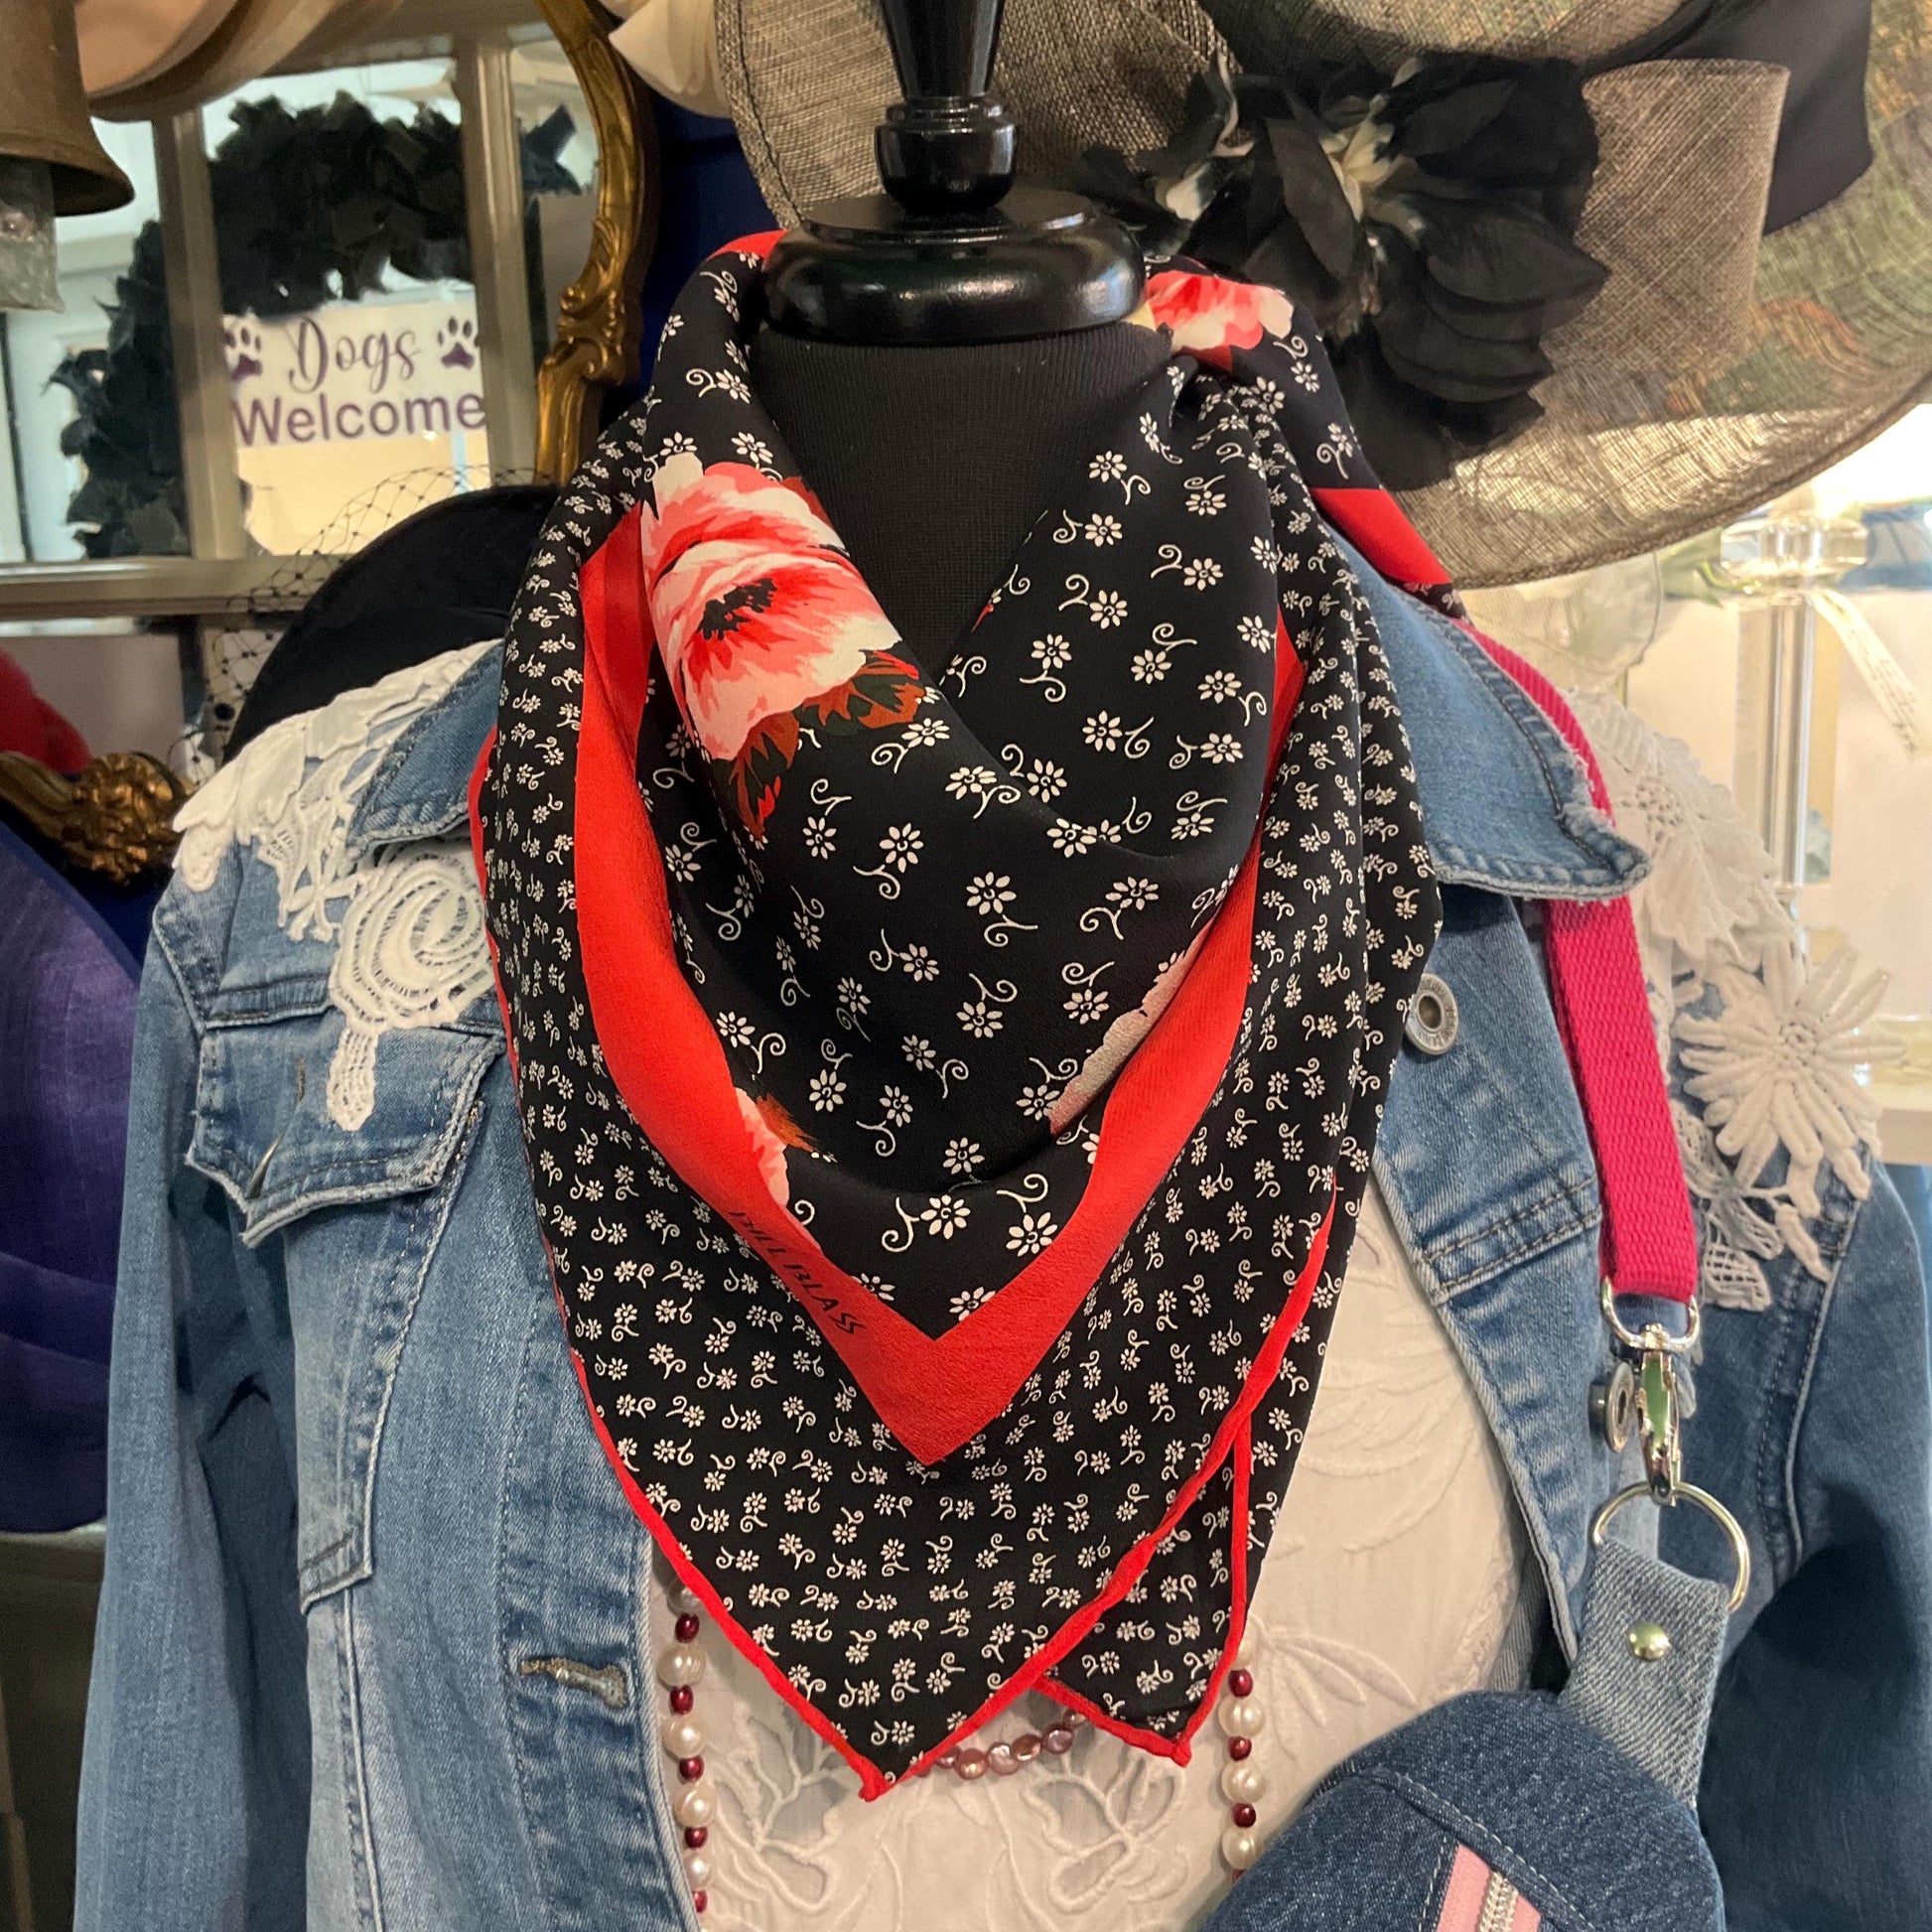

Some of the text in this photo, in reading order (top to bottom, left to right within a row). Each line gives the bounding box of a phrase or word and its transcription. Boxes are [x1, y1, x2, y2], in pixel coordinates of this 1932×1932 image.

[287, 317, 421, 394] Dogs
[232, 392, 485, 447] Welcome
[782, 1263, 868, 1335] BLASS
